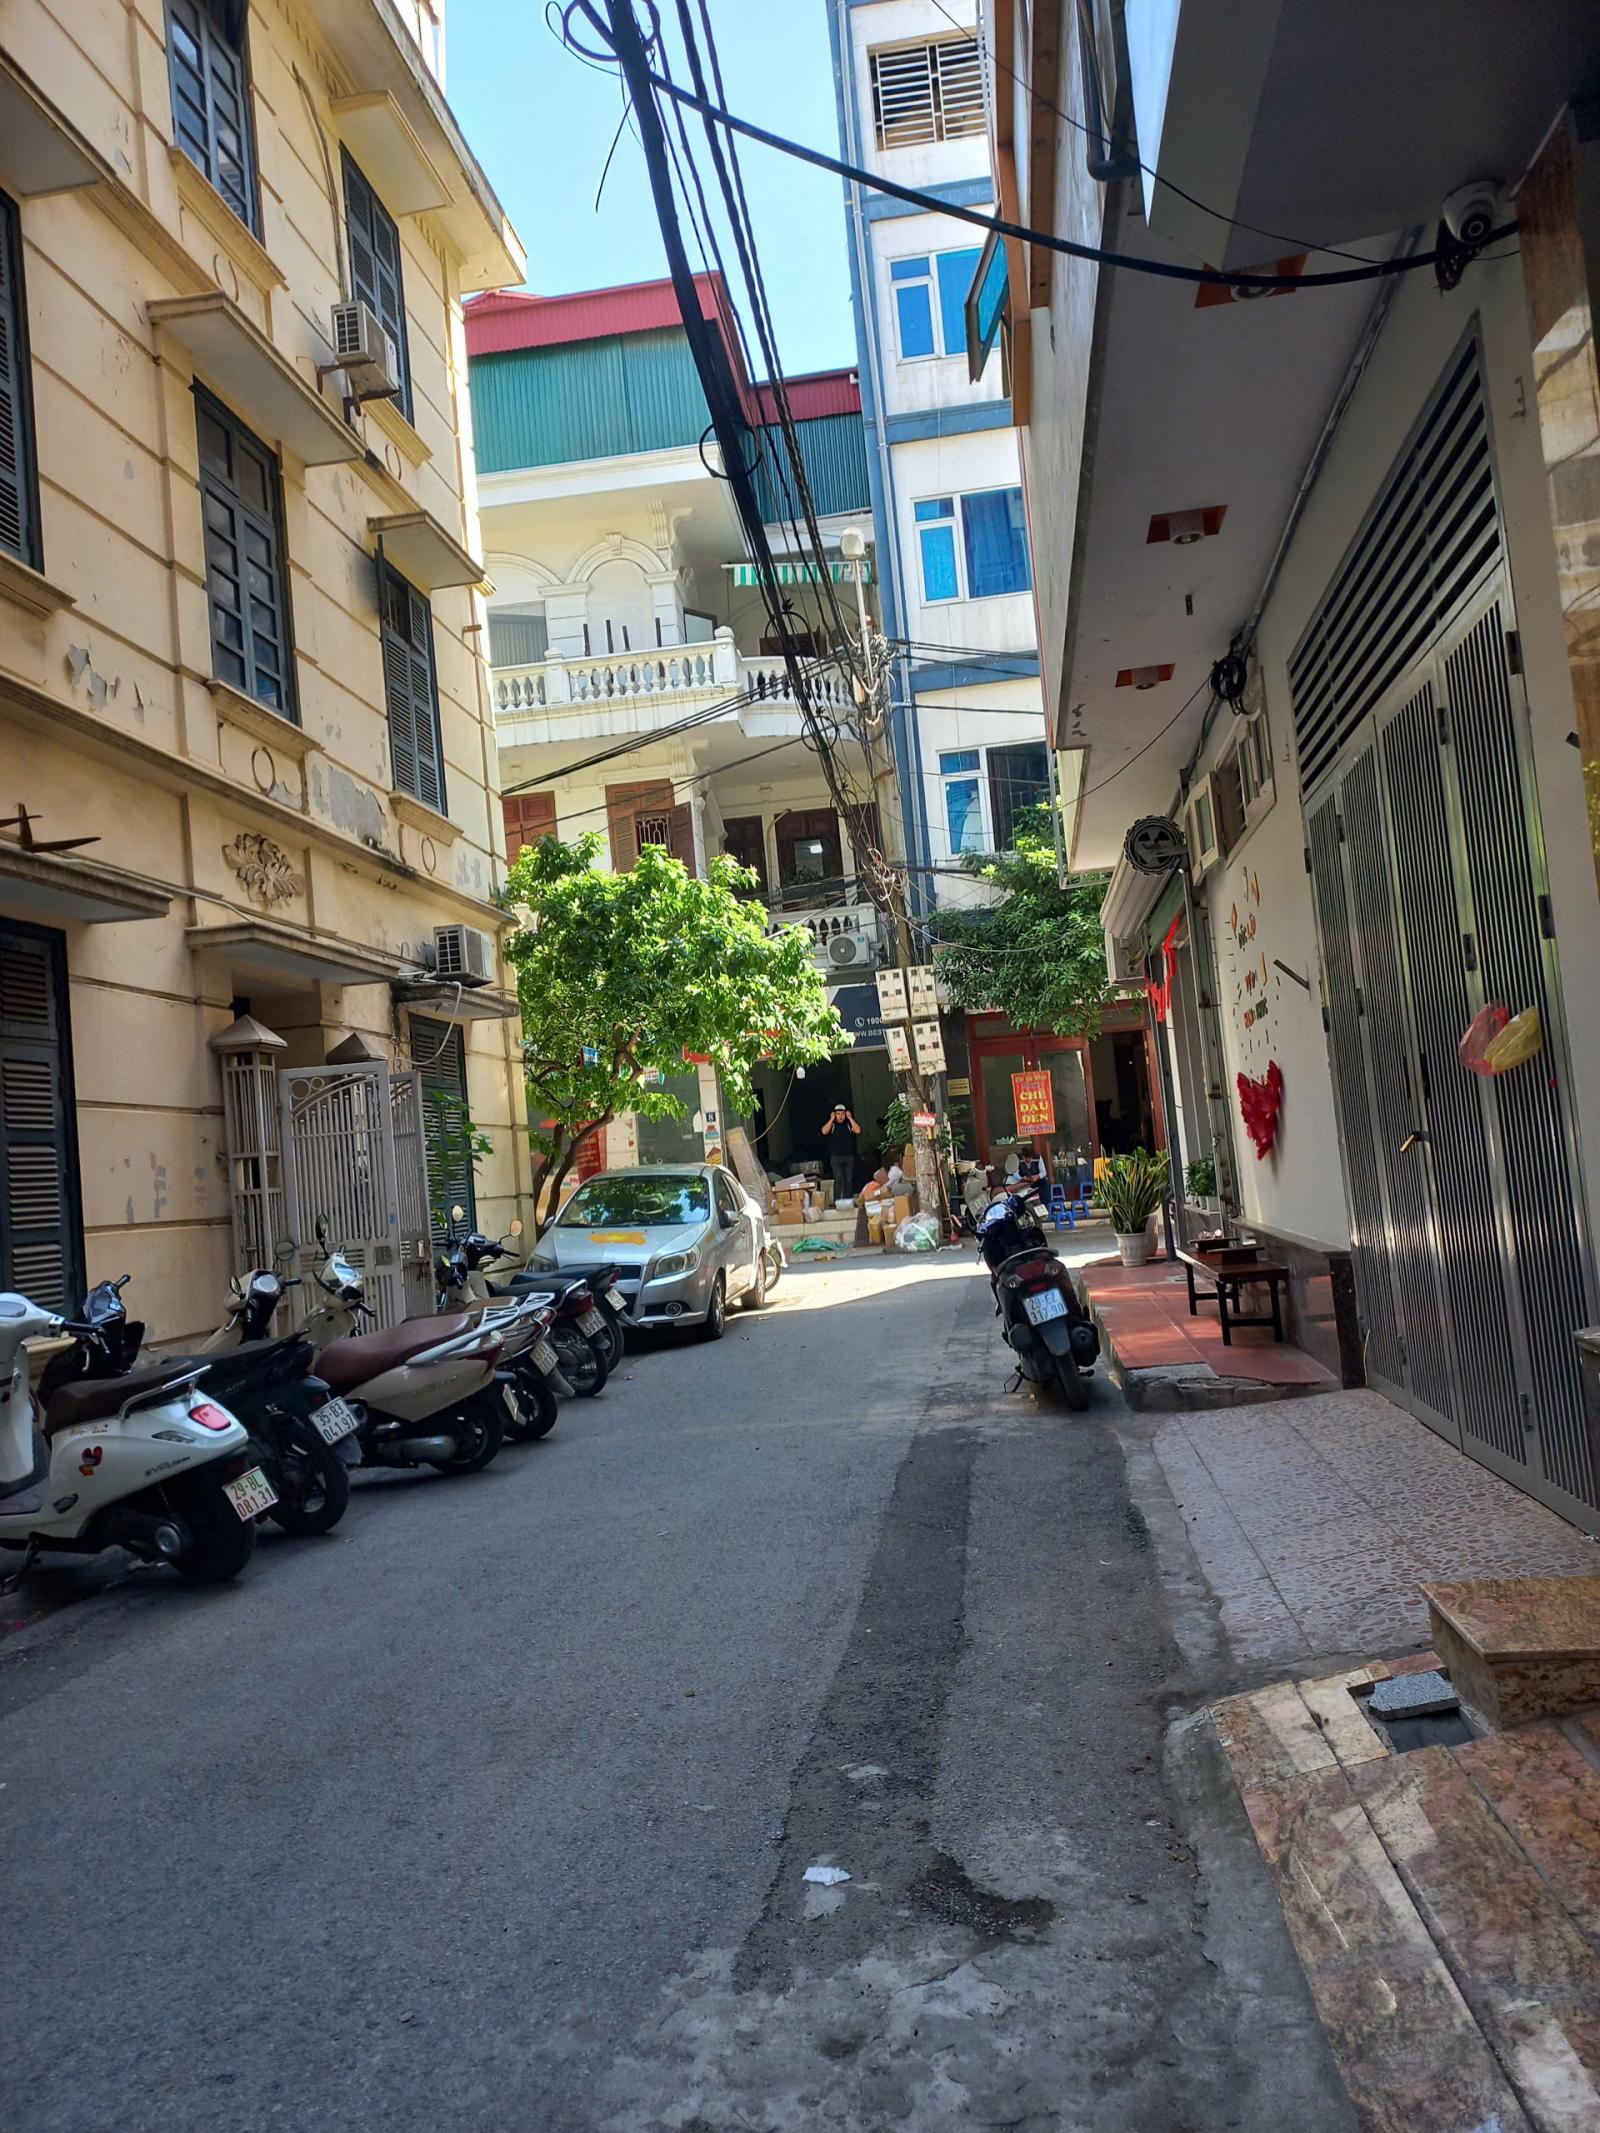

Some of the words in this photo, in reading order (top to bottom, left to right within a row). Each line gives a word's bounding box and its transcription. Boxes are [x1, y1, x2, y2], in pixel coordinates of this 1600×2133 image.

[315, 1402, 345, 1427] 35-B3
[322, 1413, 356, 1441] 041.97
[230, 1474, 264, 1501] 29-BL
[236, 1486, 276, 1518] 081.31
